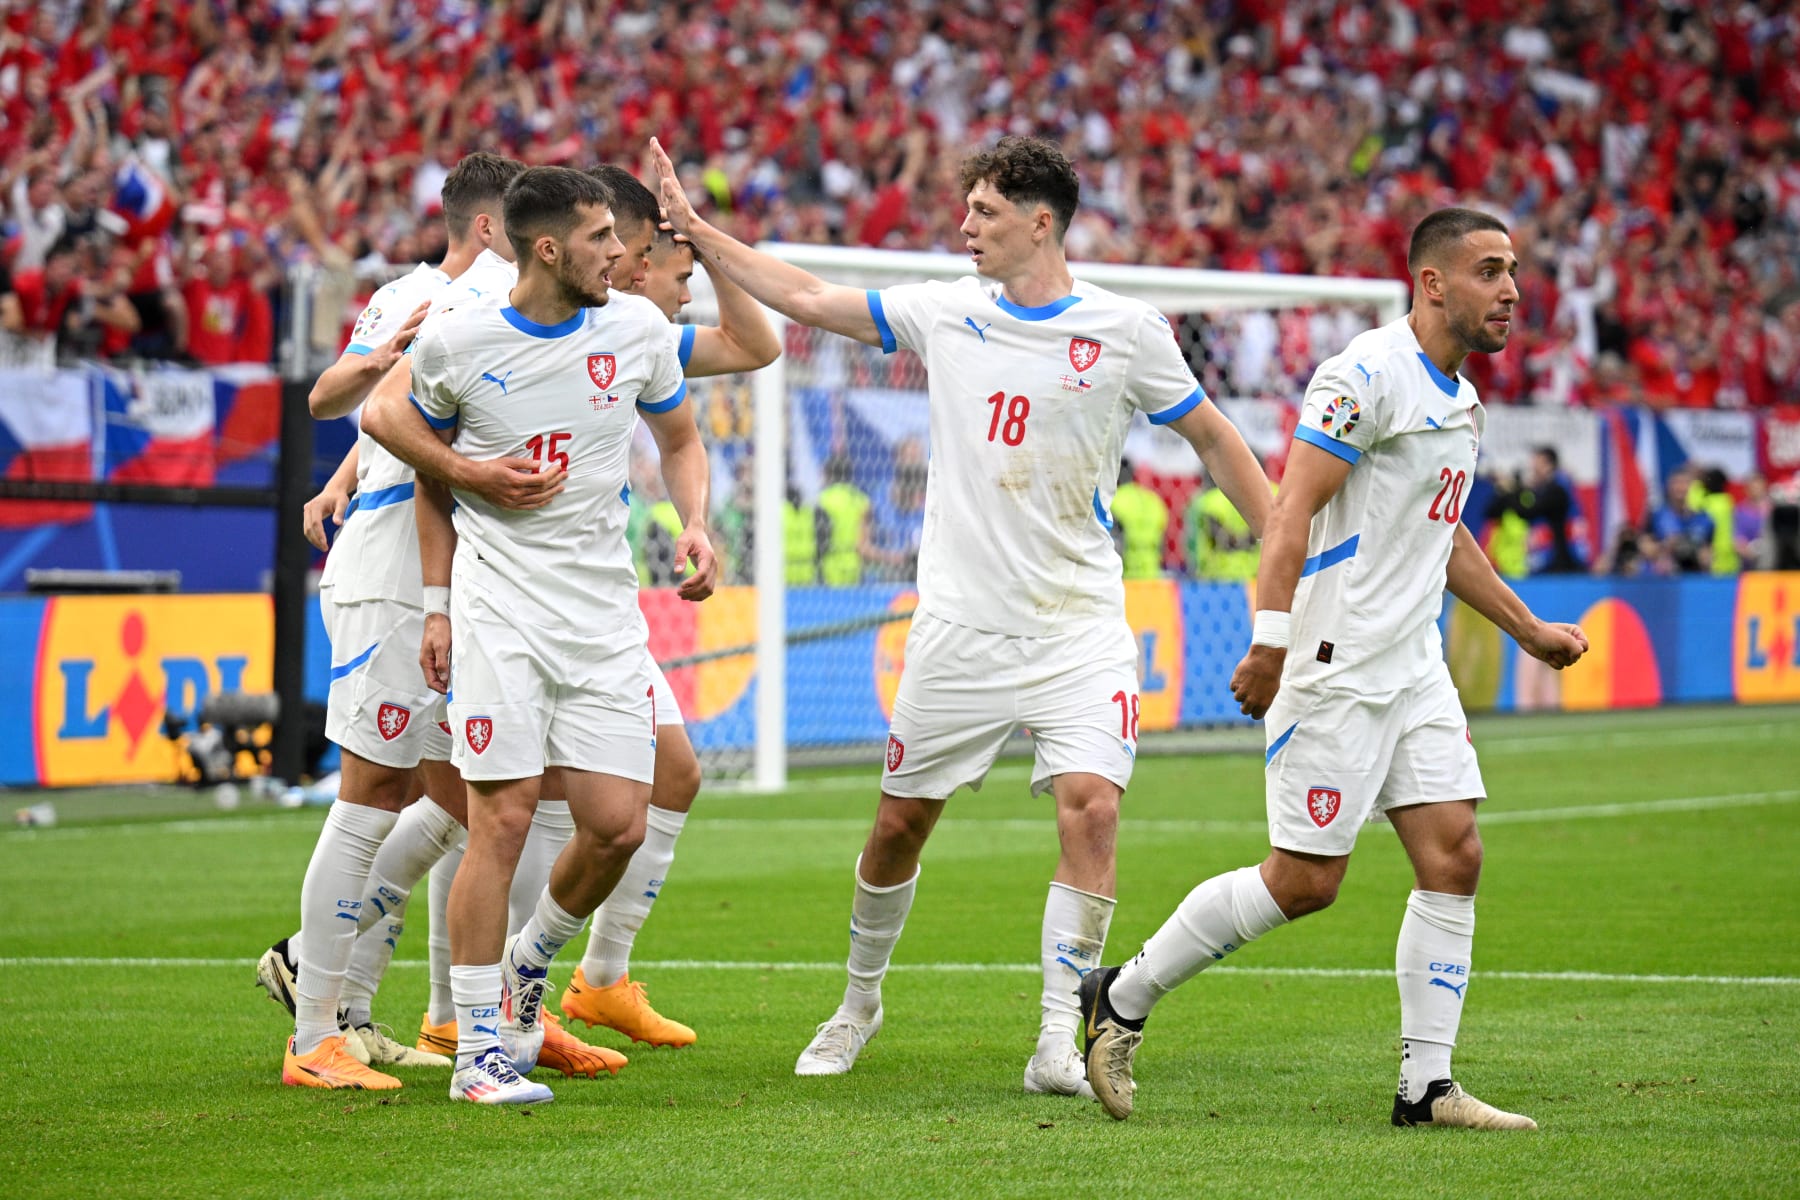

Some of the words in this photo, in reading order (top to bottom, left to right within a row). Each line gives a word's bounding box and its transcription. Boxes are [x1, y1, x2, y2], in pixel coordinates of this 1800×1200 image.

[987, 390, 1030, 447] 18
[525, 432, 572, 475] 15
[1427, 467, 1466, 524] 20
[1111, 690, 1140, 744] 18
[1056, 943, 1091, 961] CZE
[1429, 962, 1466, 976] CZE
[471, 1007, 499, 1018] CZE
